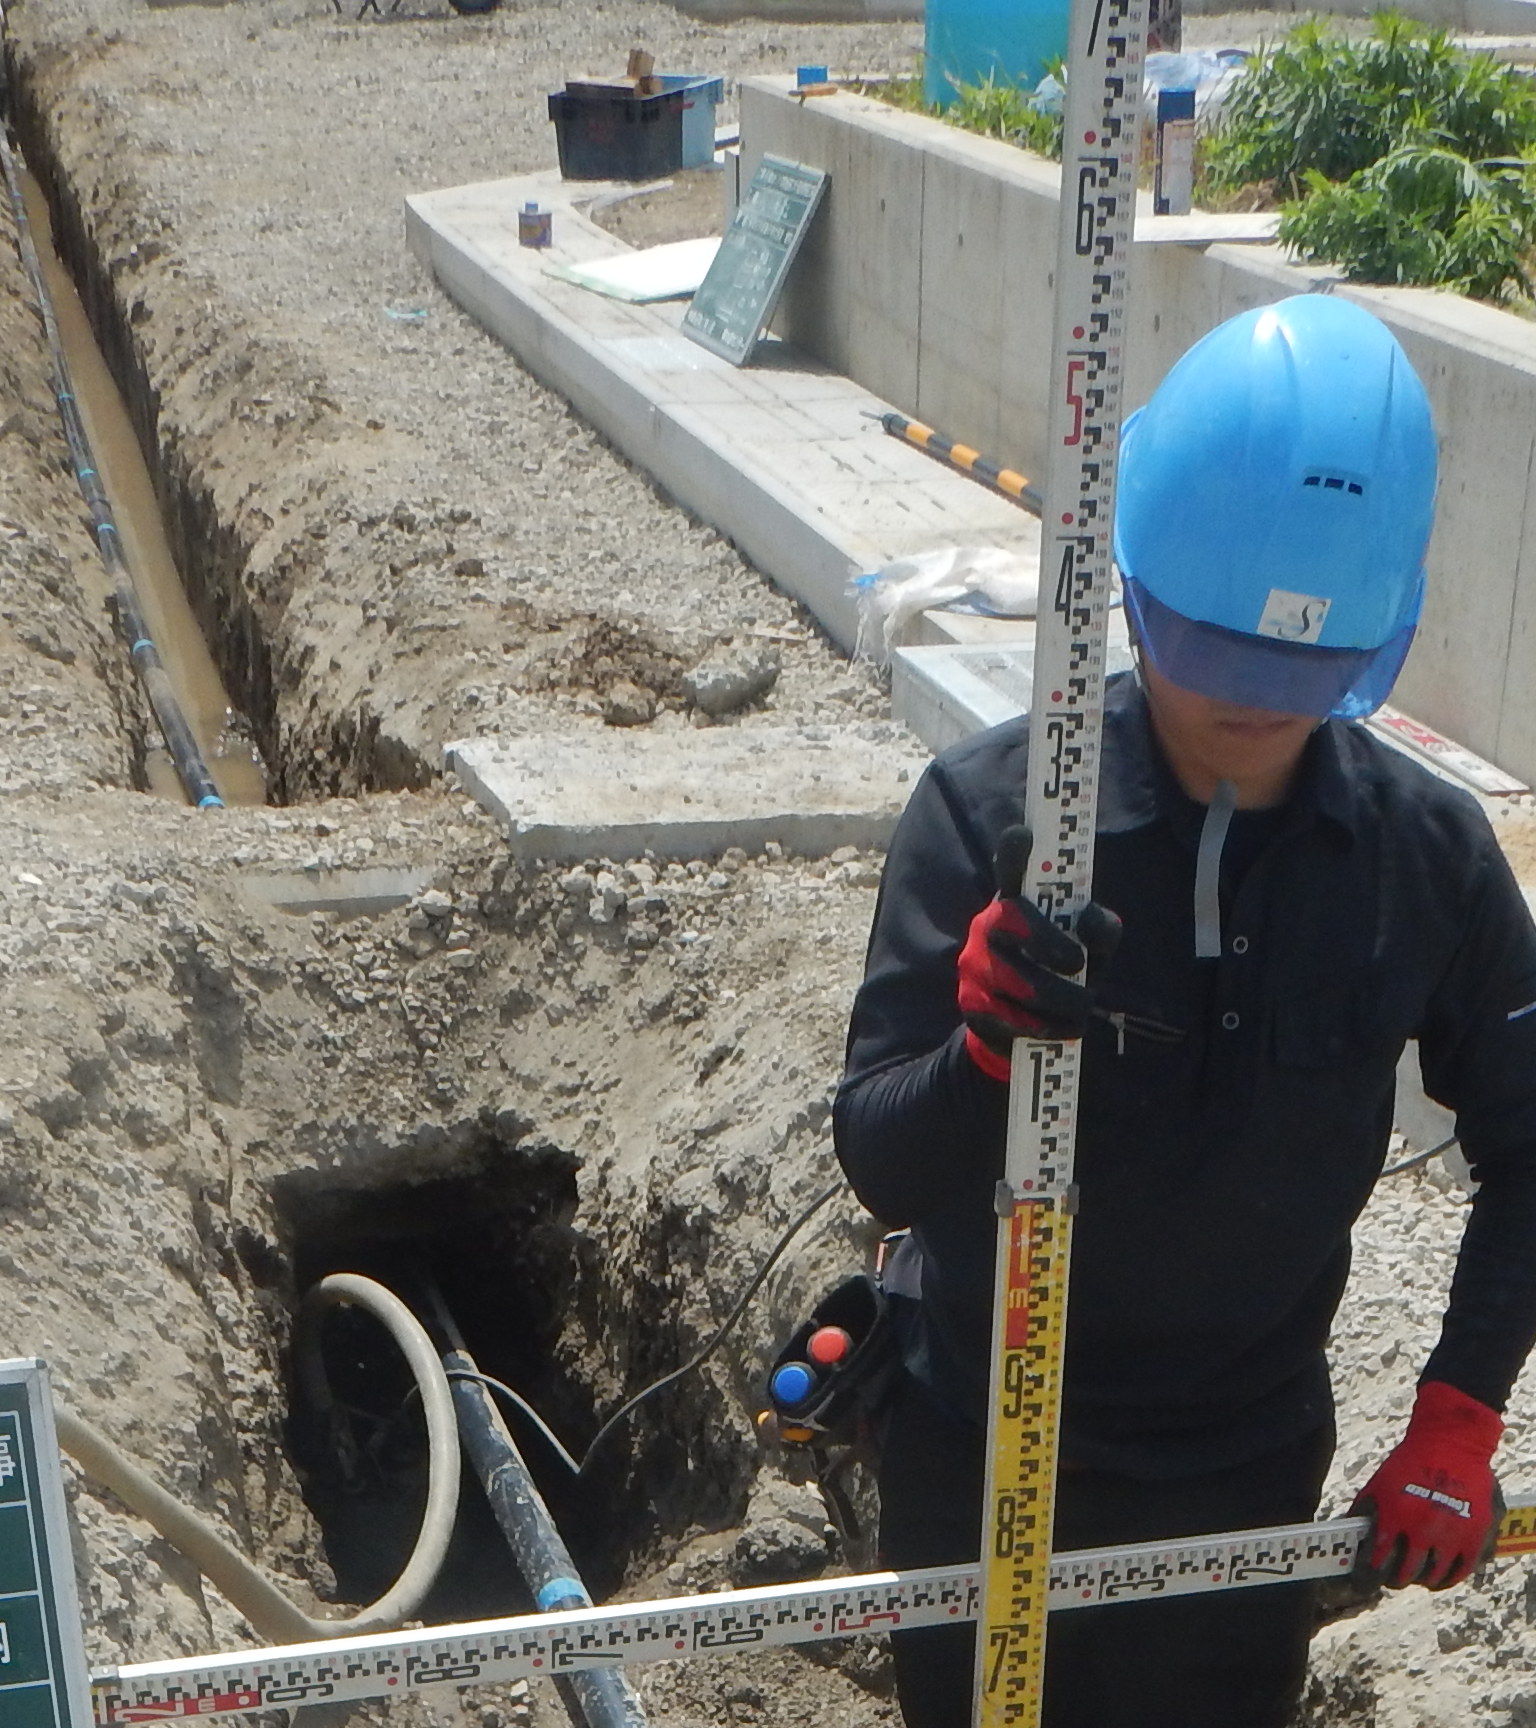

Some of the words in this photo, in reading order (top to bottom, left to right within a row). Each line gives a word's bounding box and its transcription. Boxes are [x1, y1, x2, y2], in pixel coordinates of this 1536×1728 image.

[1063, 361, 1085, 446] 5
[1054, 545, 1074, 627] 4
[1043, 721, 1064, 799] 3
[1003, 1353, 1024, 1420] 9
[995, 1496, 1015, 1559] 8
[988, 1632, 1009, 1693] 7
